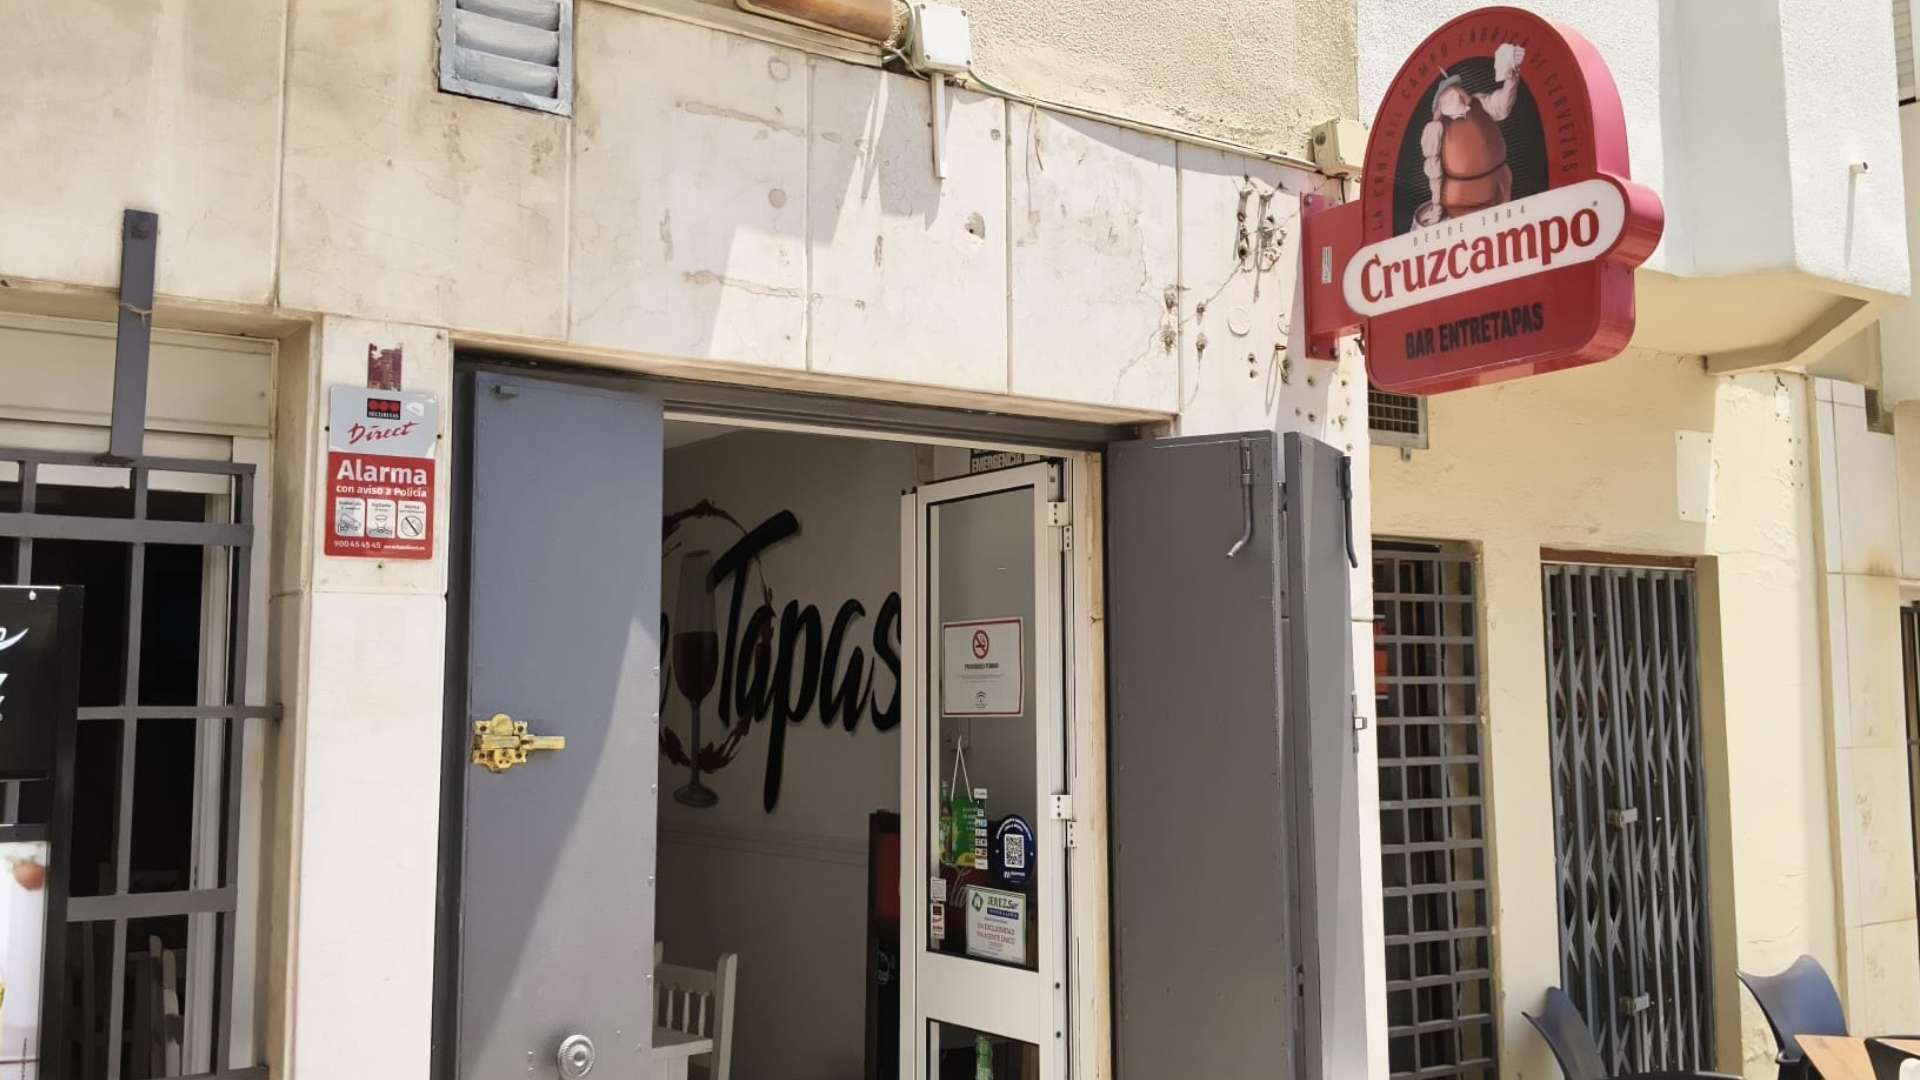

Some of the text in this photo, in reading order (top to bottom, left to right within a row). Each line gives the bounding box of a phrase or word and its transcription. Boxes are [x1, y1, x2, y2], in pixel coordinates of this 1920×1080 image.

[1412, 222, 1465, 247] DESDE
[1360, 207, 1600, 303] Cruzcampo
[1405, 302, 1545, 361] BAR ENTRETAPAS
[347, 420, 421, 445] Direct
[336, 459, 428, 486] Alarma
[336, 485, 354, 493] con
[356, 485, 383, 496] aviso
